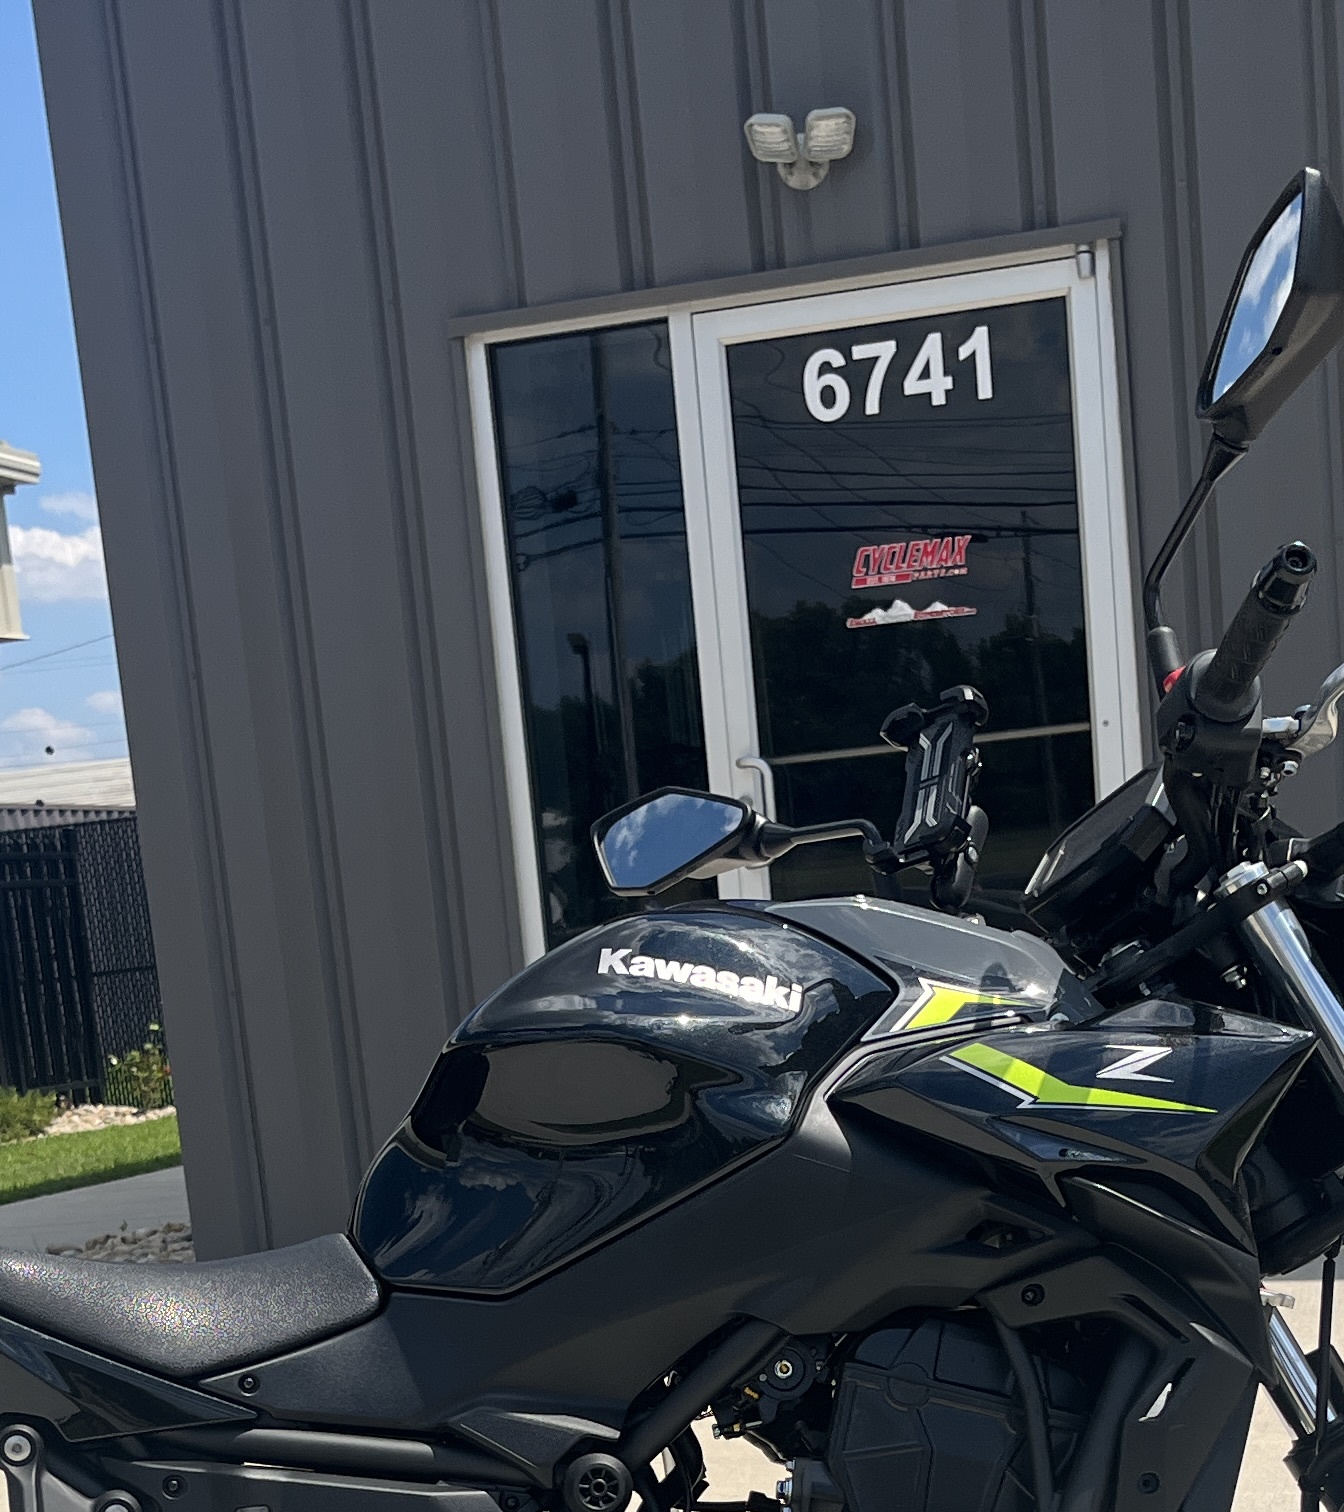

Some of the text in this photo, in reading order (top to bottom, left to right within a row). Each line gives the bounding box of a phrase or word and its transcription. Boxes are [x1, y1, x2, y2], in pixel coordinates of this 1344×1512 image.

[802, 324, 993, 422] 6741
[853, 535, 972, 576] CYCLEMAX
[597, 948, 804, 1013] Kawasaki
[1096, 1044, 1174, 1083] Z
